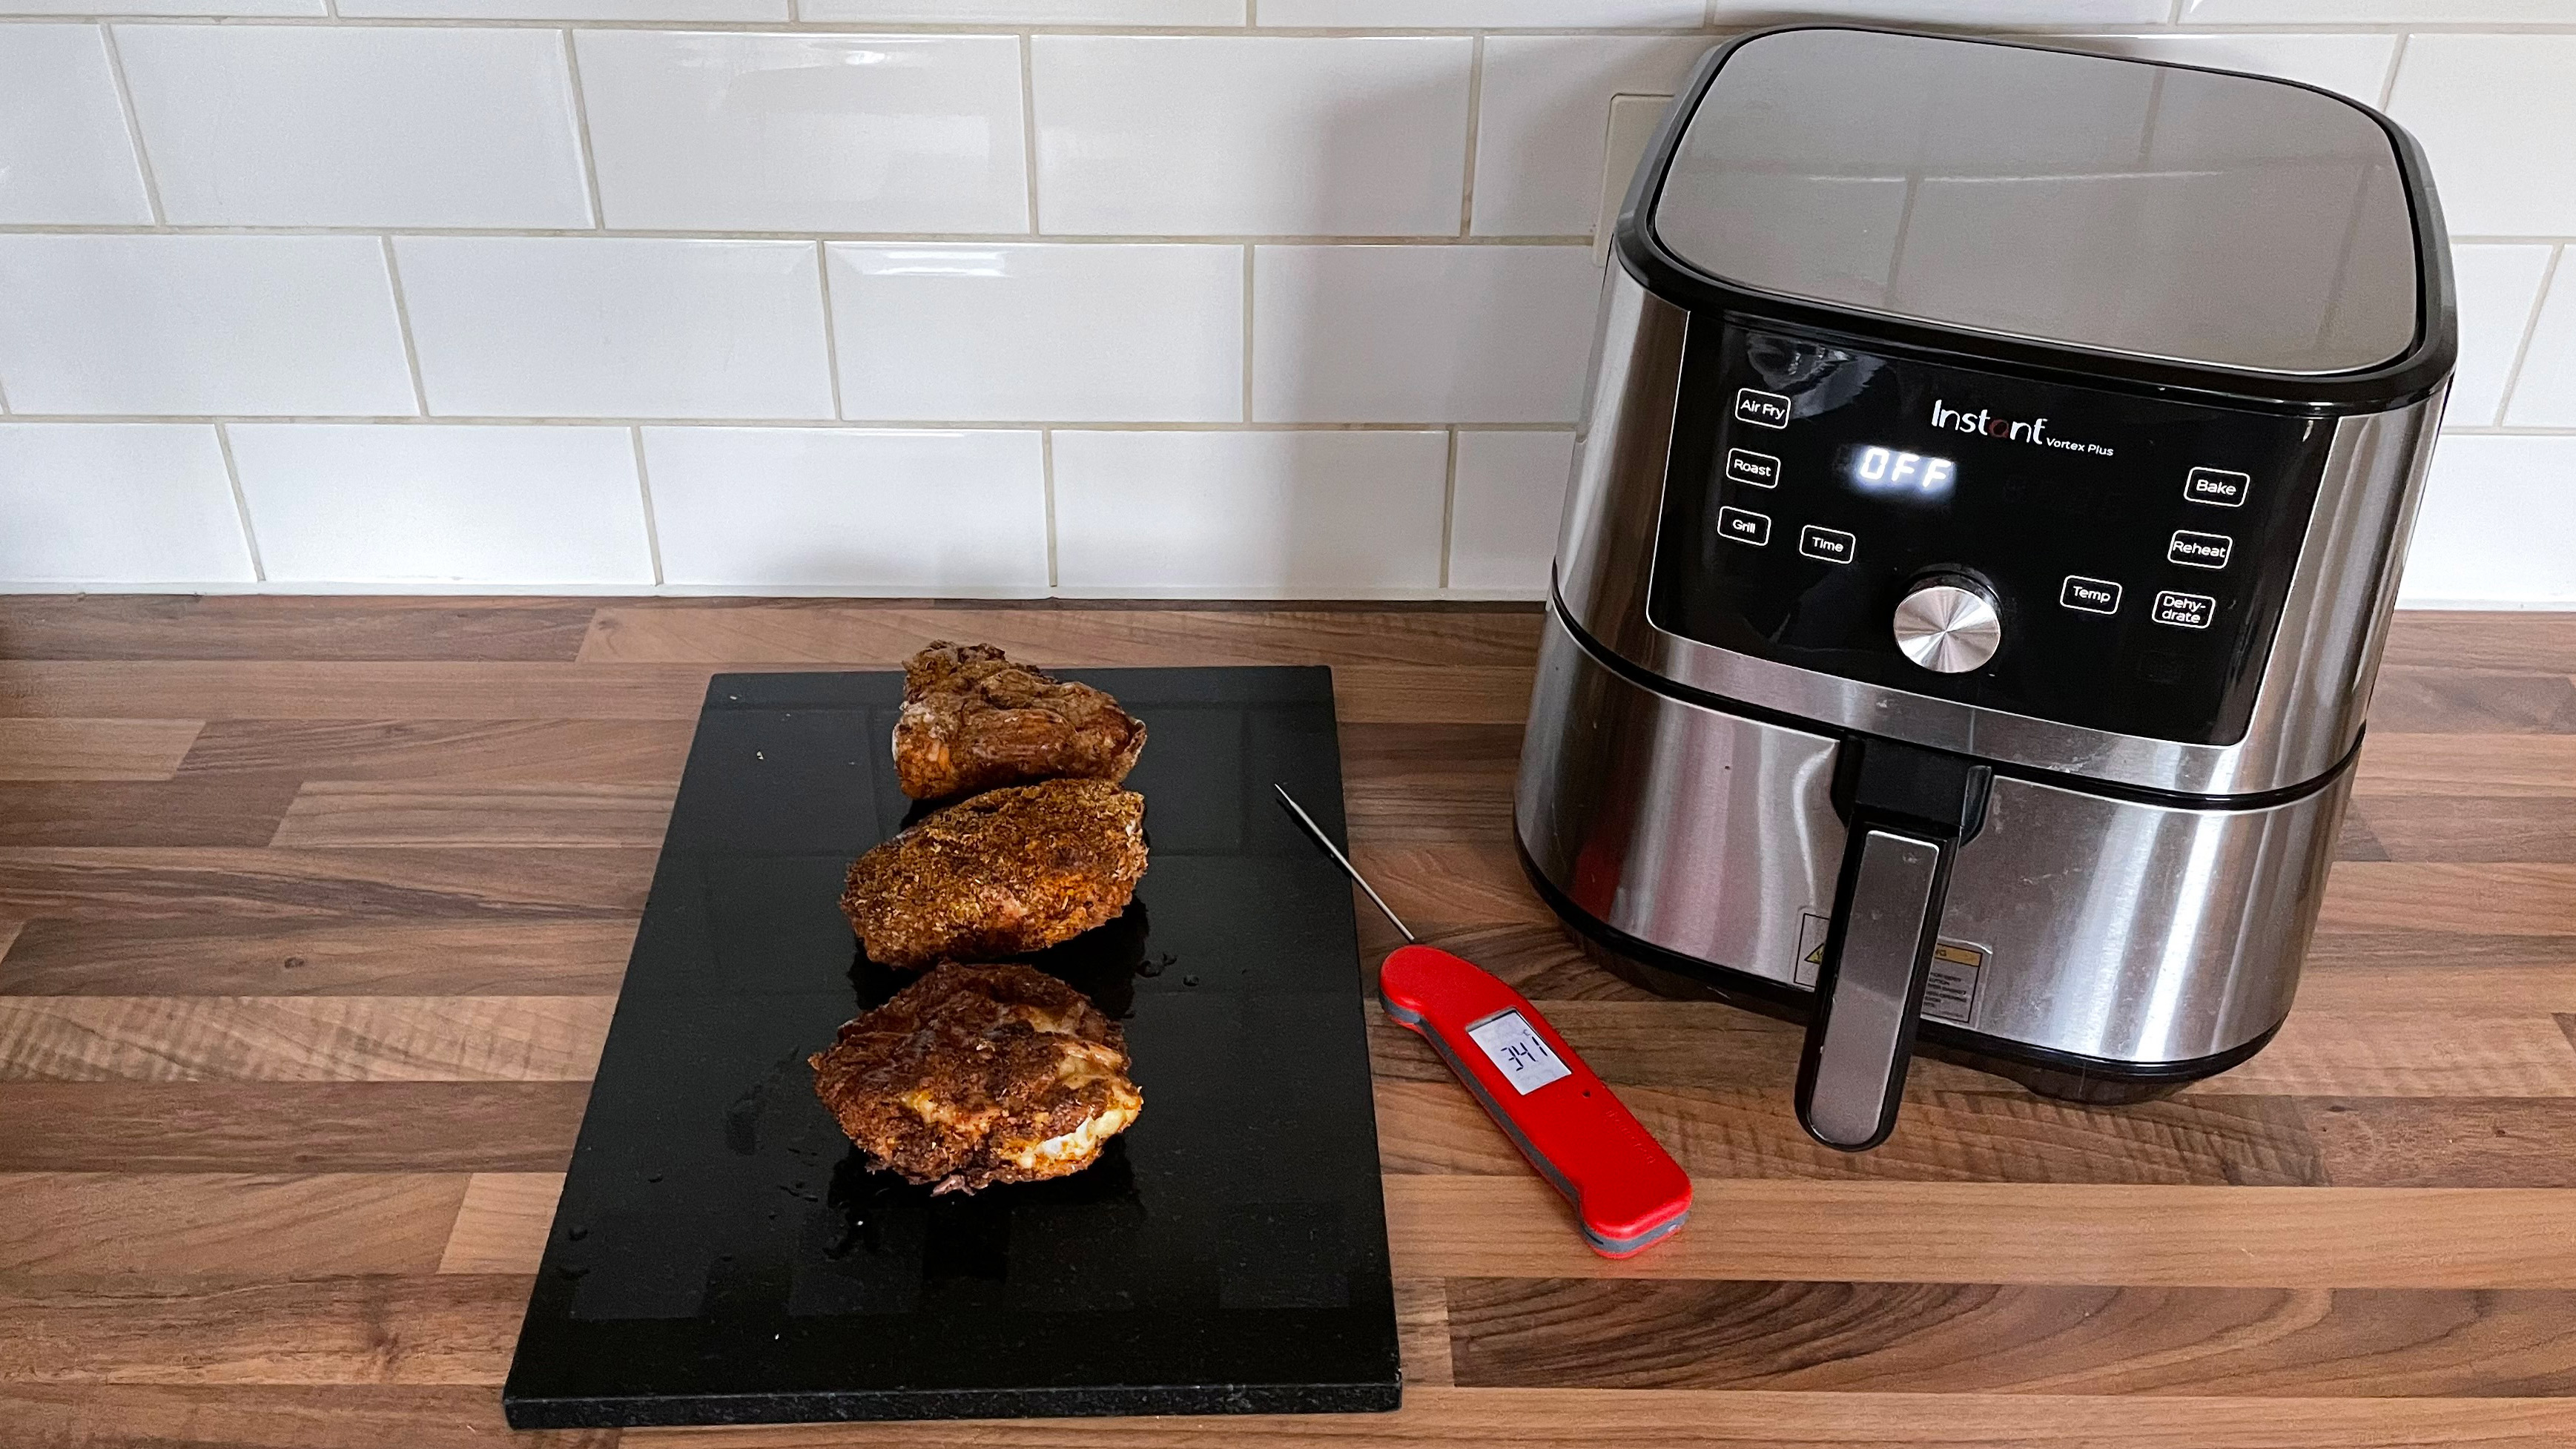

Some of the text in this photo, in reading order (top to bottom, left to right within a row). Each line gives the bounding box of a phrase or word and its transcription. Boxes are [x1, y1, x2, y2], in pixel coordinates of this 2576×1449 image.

[1740, 399, 1786, 420] Air Fry
[1931, 399, 2048, 444] Instant
[2046, 437, 2114, 457] Vortex Plus
[1733, 458, 1771, 477] Roast
[1859, 446, 1952, 488] OFF
[2196, 478, 2236, 496] Bake
[1732, 519, 1756, 534] Grill
[1812, 536, 1844, 553] Time
[2172, 540, 2226, 558] Reheat
[2073, 585, 2111, 604] Temp
[2162, 595, 2206, 612] Dehy-
[2161, 609, 2201, 624] drate
